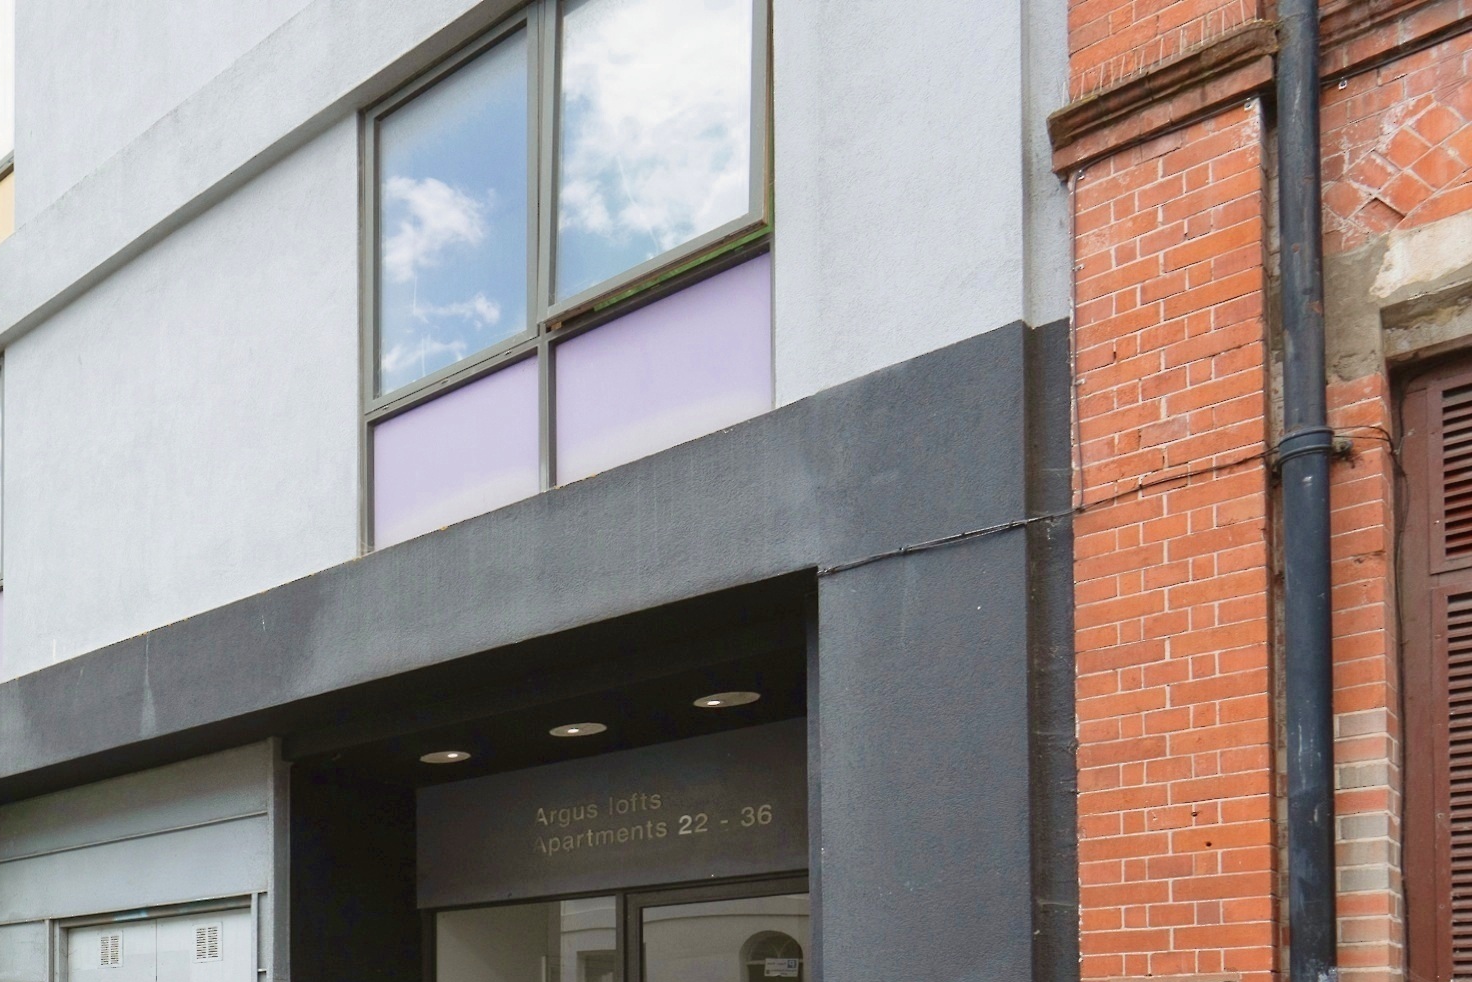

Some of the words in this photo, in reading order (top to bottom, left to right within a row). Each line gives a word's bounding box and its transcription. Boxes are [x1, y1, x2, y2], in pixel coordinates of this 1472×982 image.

[534, 820, 668, 856] Apartments
[678, 813, 709, 836] 22
[740, 804, 772, 827] 36
[535, 803, 598, 827] Argus
[608, 792, 662, 816] lofts
